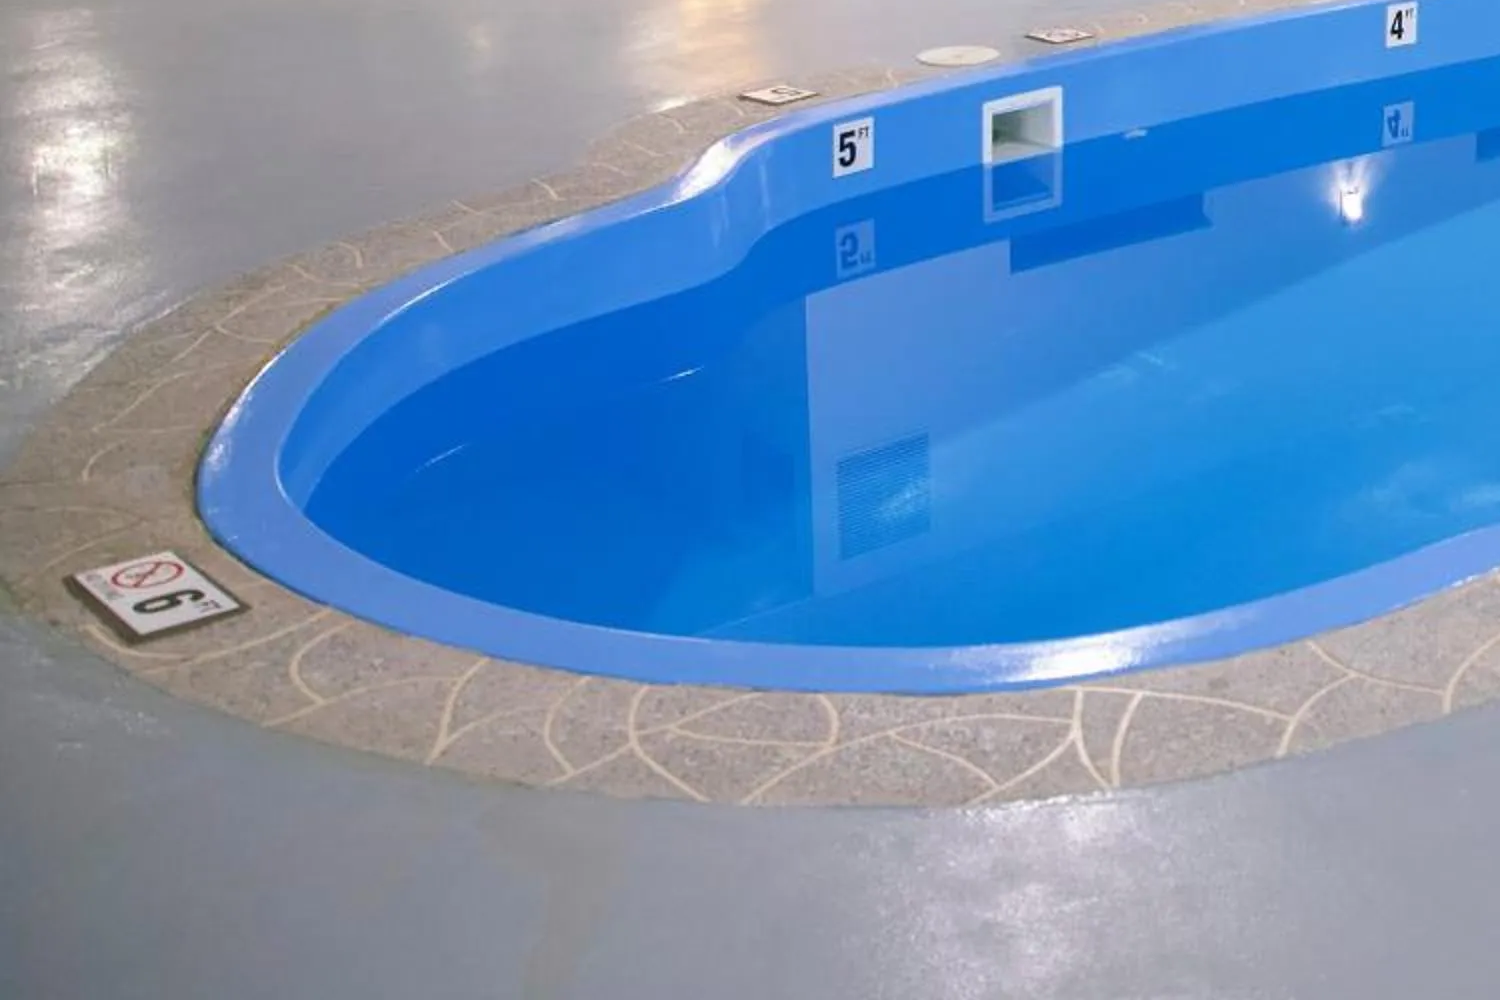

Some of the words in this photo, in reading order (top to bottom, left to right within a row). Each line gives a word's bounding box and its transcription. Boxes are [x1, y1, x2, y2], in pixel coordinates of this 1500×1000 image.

[1389, 10, 1404, 40] 4
[838, 130, 857, 168] 5
[858, 126, 870, 139] FT
[132, 588, 206, 615] 6
